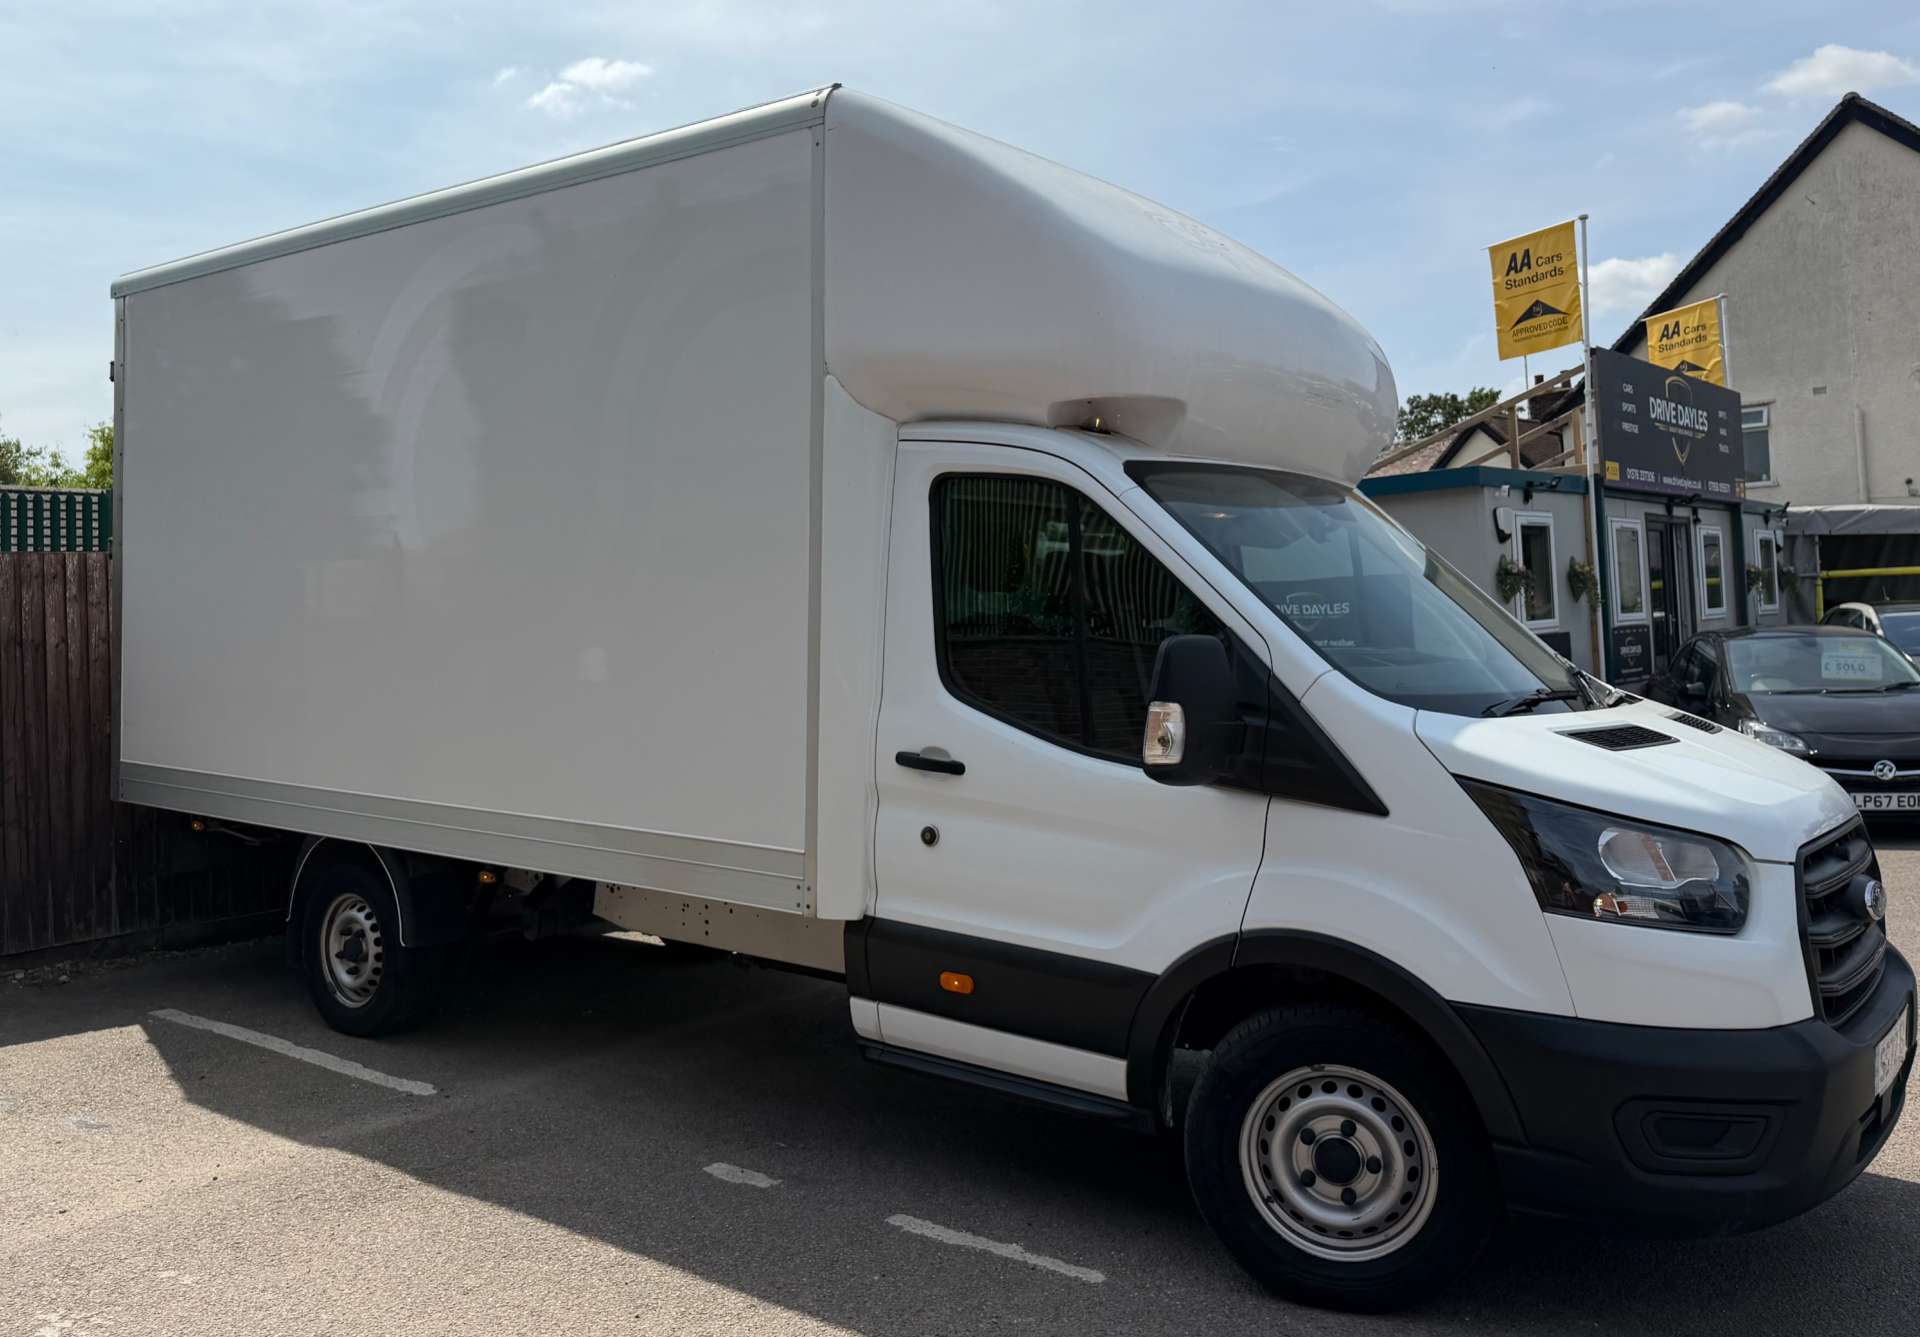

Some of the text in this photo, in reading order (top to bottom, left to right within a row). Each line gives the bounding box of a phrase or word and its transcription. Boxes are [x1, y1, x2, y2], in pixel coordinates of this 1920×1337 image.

[1505, 248, 1563, 277] AA Cars
[1504, 265, 1564, 290] Standards
[1512, 322, 1547, 337] APPROVED
[1548, 316, 1568, 329] CODE
[1659, 320, 1707, 342] AA Cars
[1658, 333, 1708, 353] Standards
[1649, 396, 1708, 432] DRIVE DAYLES
[1275, 602, 1351, 615] IVE DAYLES
[1853, 795, 1892, 808] LP67
